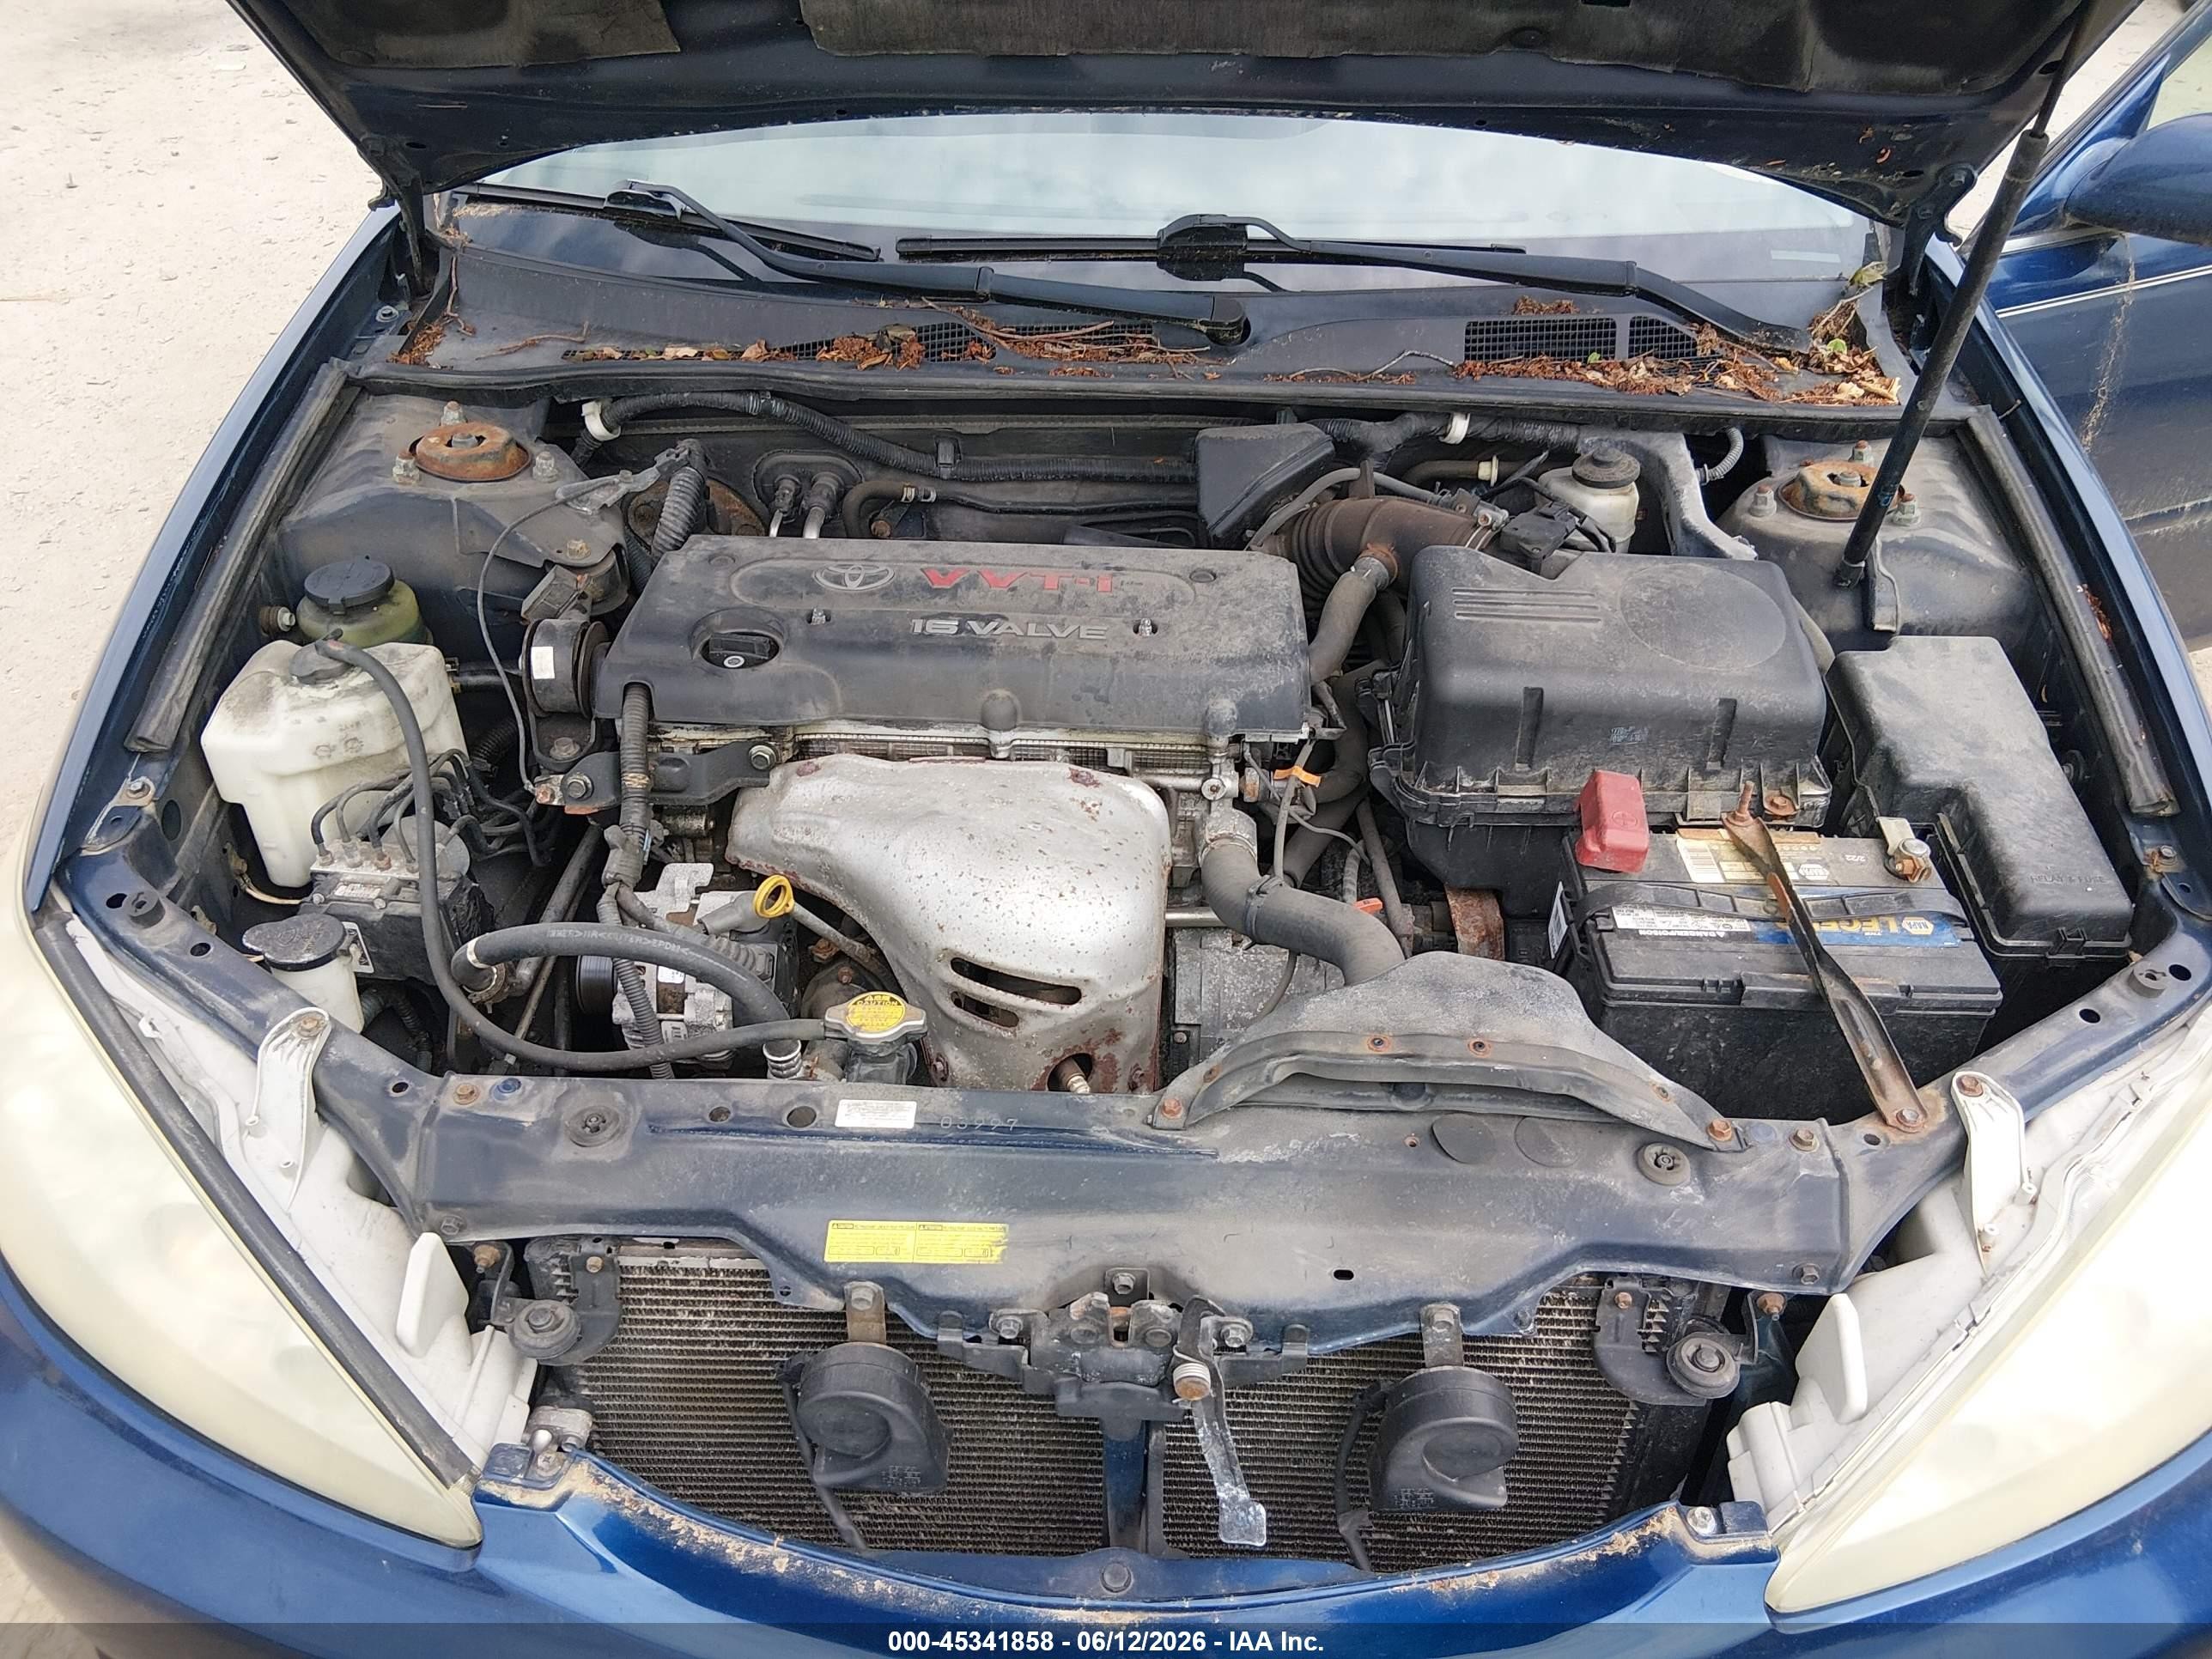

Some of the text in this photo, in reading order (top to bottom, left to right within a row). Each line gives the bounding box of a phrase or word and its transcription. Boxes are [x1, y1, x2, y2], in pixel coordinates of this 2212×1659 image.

[910, 618, 1109, 640] 16 VALVE
[1905, 921, 1929, 930] NAPA
